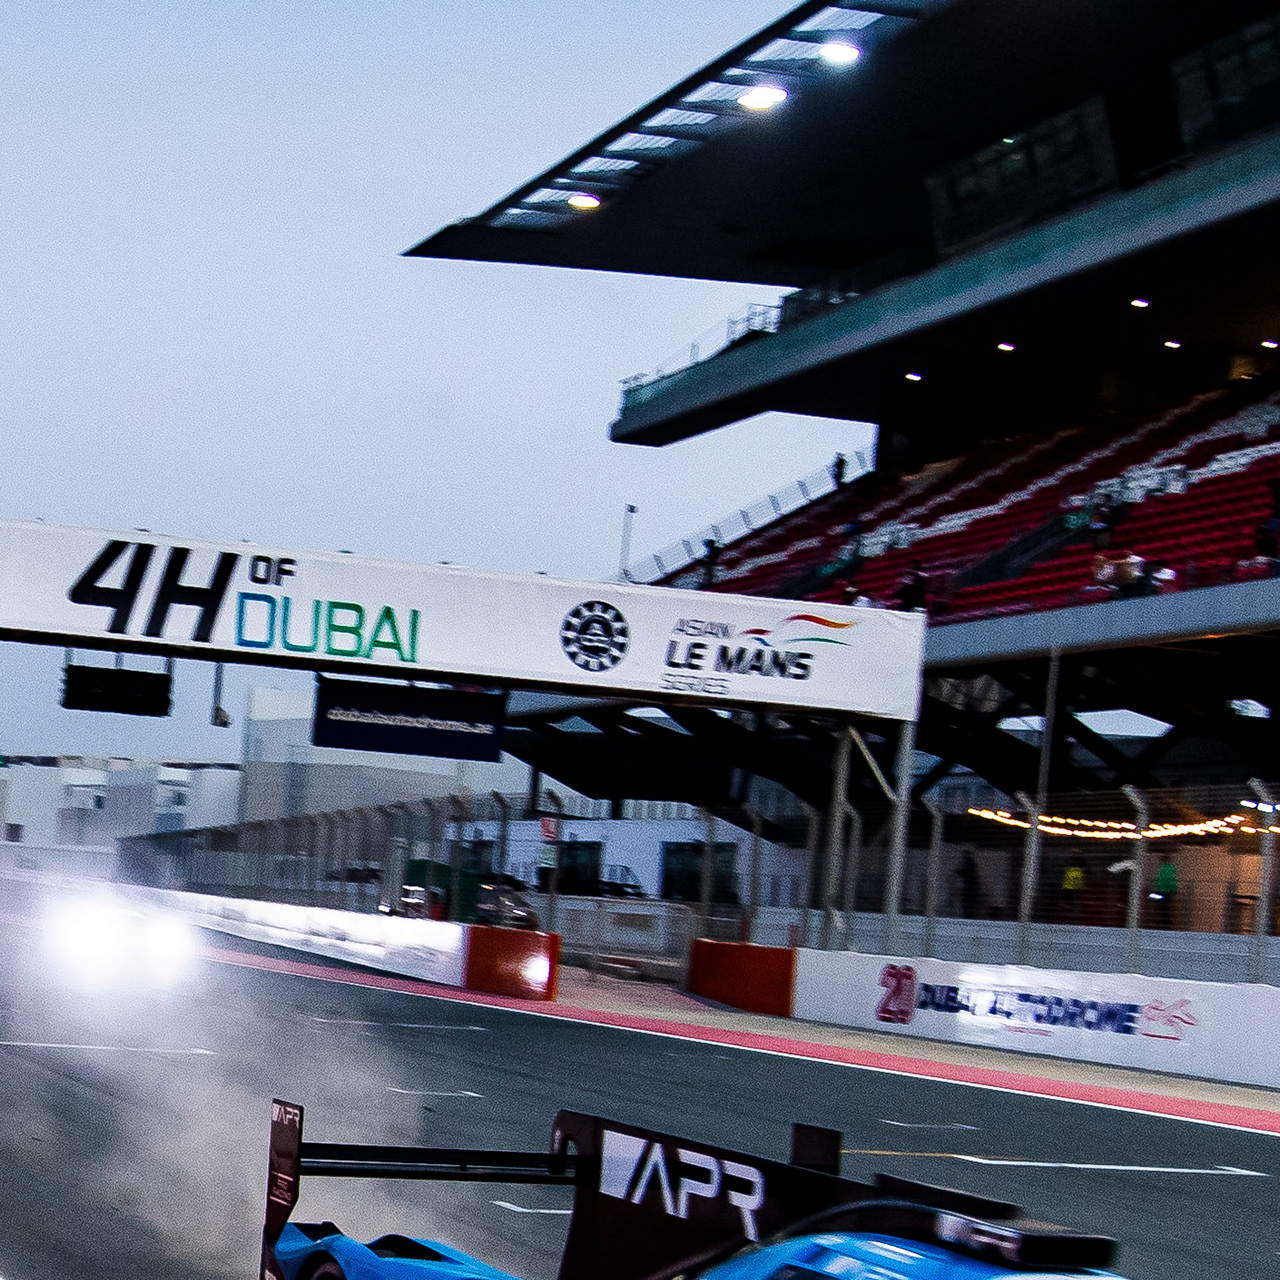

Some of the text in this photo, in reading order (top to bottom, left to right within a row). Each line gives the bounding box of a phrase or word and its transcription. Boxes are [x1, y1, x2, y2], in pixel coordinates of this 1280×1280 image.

[67, 538, 242, 643] 4H
[249, 555, 297, 586] OF
[235, 591, 422, 663] DUBAI
[664, 640, 815, 681] LE MANS
[630, 1142, 766, 1243] APR
